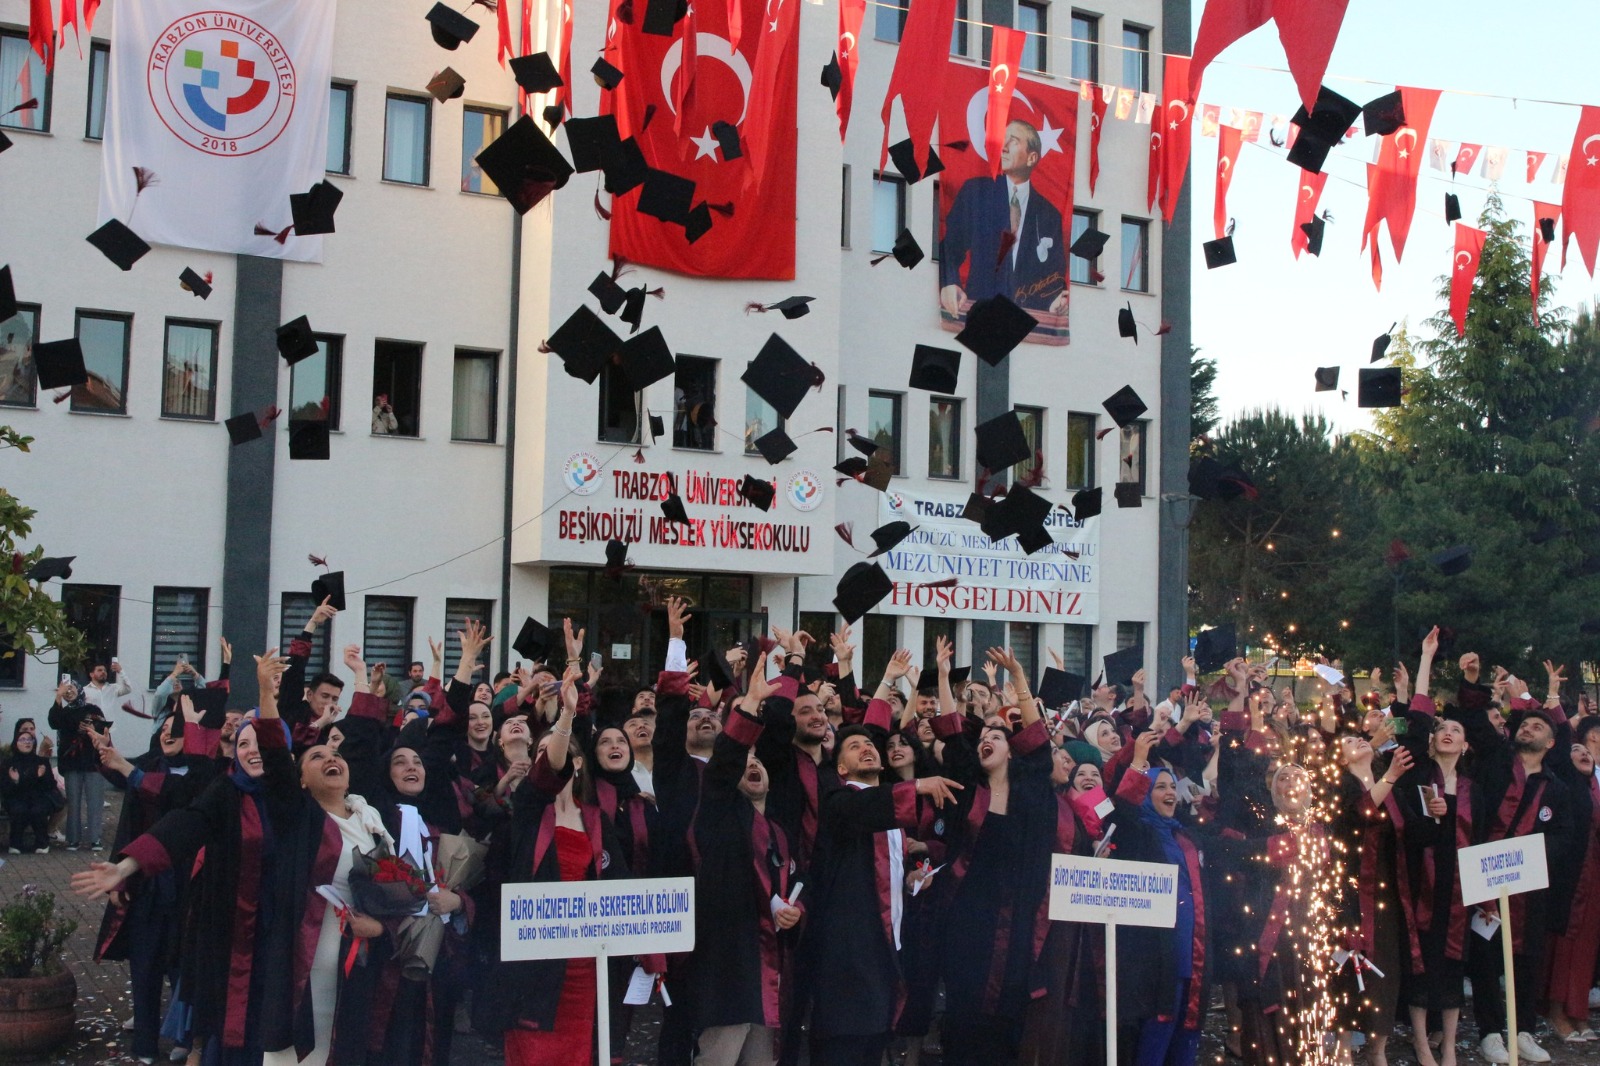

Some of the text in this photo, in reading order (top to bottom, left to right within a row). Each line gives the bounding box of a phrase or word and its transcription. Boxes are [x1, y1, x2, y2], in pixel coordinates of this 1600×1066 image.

[153, 14, 294, 97] TRABZON ÜNİVERSİTESİ
[201, 137, 238, 151] 2018
[613, 470, 678, 501] TRABZON
[914, 500, 967, 519] TRABZ
[559, 505, 810, 552] BEŞİKDÜZÜ MESLEK YÜKSEKOKULU
[961, 534, 1010, 551] MESLEK
[886, 550, 1092, 583] MEZUNİYET TÖRENİNE
[891, 582, 1082, 614] HOŞGELDİNİZ
[1055, 865, 1172, 894] BÜRO HİZMETLERİ ve SEKRETERLİK BÖLÜMÜ
[510, 889, 688, 920] BÜRO HİZMETLERİ ve SEKRETERLİK BÖLÜMÜ
[518, 920, 682, 940] BÜRO YÖNETİMİ ve YÖNETİCİ ASİSTANLIĞI PROGRAMI
